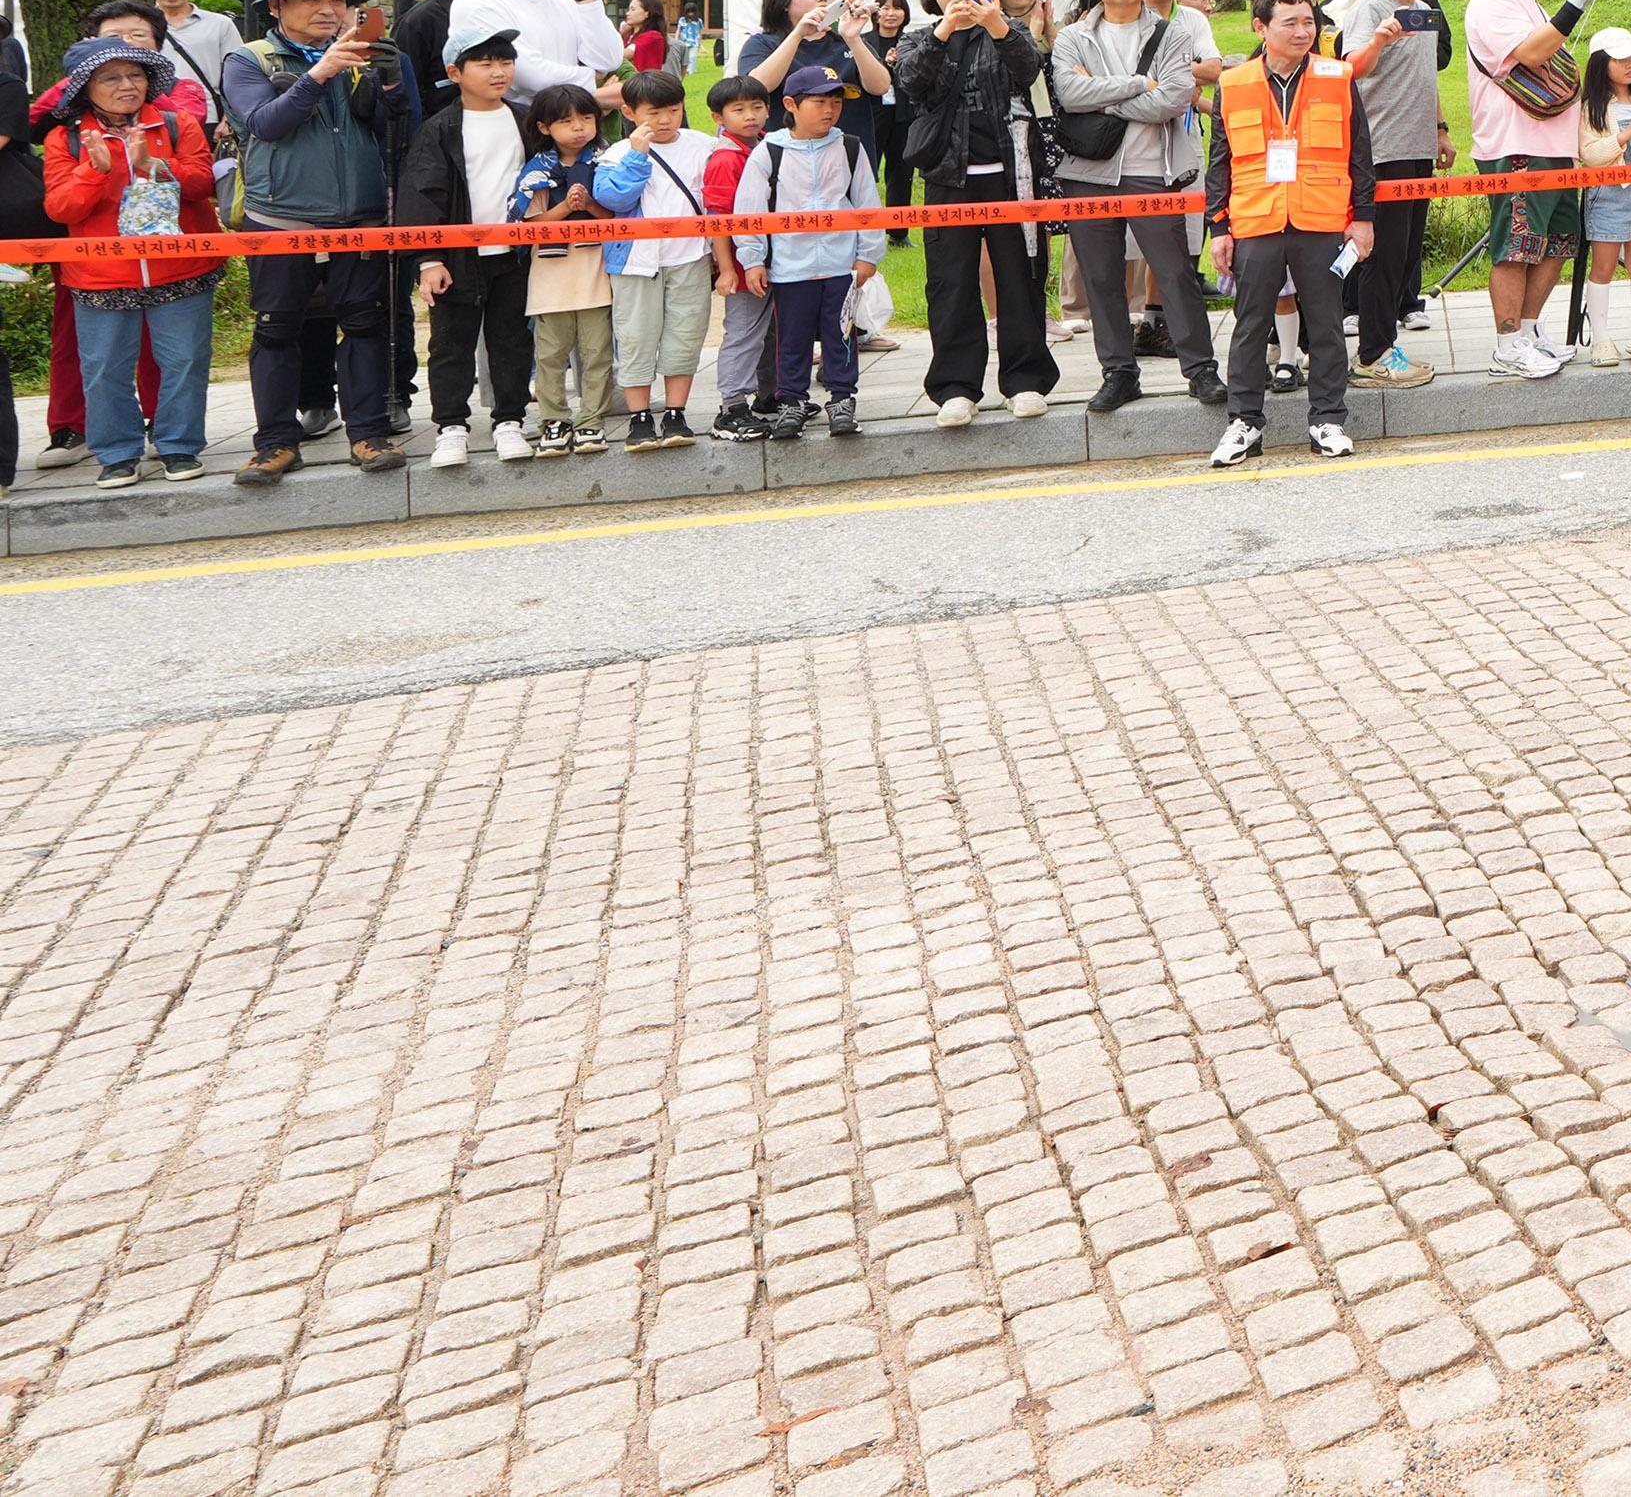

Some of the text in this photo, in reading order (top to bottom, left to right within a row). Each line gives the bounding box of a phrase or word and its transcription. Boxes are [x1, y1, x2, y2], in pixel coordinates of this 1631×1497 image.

[1391, 177, 1510, 197] 경찰통제선 경찰서장
[1557, 170, 1588, 185] 이선을
[893, 205, 1007, 224] 이선을 넘지마시오.
[1060, 196, 1188, 216] 경찰통제선 경찰서장
[509, 223, 636, 241] 이선을 넘지마시오.
[695, 213, 835, 233] 경찰통제선 경찰서장
[75, 238, 220, 257] 이선을 넘지마시오.
[287, 230, 445, 250] 경찰통제선 경찰서장
